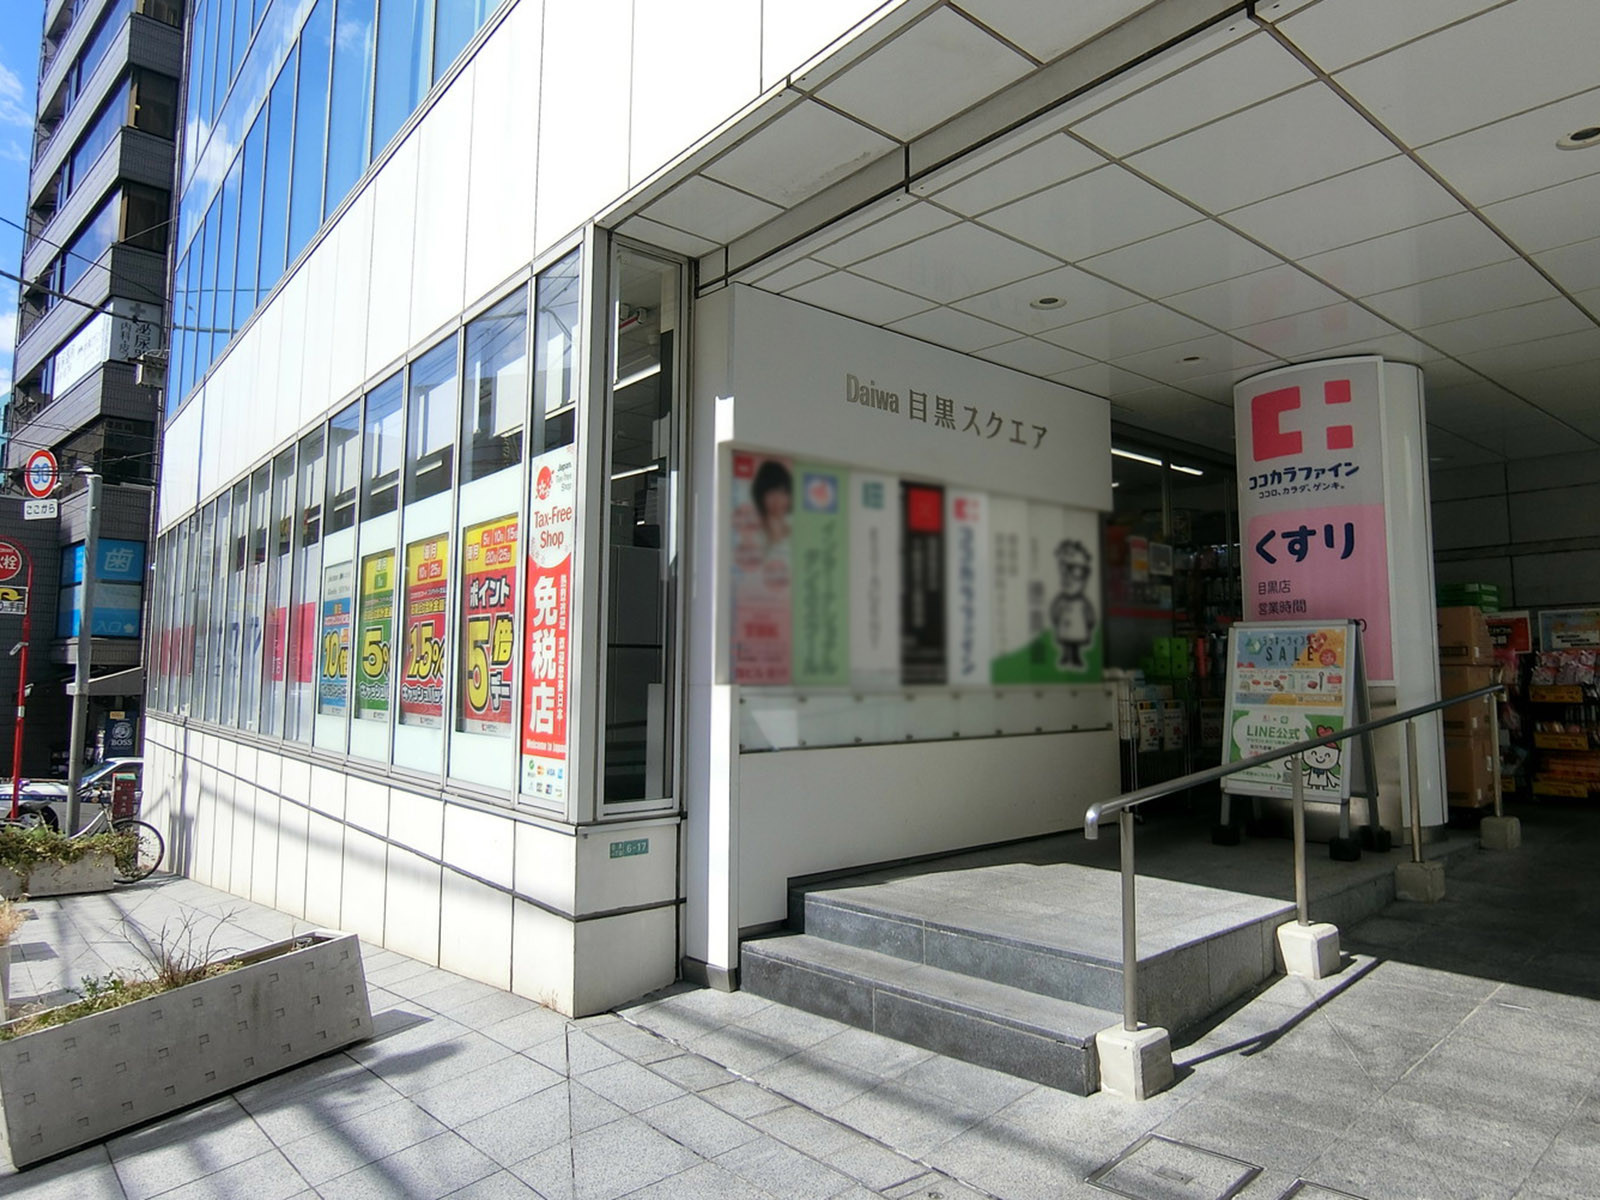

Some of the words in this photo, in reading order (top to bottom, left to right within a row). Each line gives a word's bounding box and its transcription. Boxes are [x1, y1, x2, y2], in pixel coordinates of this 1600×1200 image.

[846, 373, 900, 414] Daiwa
[908, 388, 1048, 450] 目黒スクエア
[33, 463, 49, 484] 30
[1248, 461, 1360, 491] ココカラファイン
[1258, 481, 1345, 500] ココロ、カラダ、ゲンキ。
[26, 503, 55, 515] ここから
[534, 505, 572, 529] Tax-Free
[540, 529, 564, 549] Shop
[1255, 522, 1355, 565] くすり
[104, 547, 135, 572] 歯
[469, 574, 511, 609] ポイント
[1258, 579, 1291, 595] 目黒店
[1258, 599, 1307, 616] 営業時間
[529, 575, 558, 735] 免税店
[1265, 645, 1315, 662] SALE
[111, 738, 133, 746] BOSS
[1246, 725, 1300, 740] LINE公式
